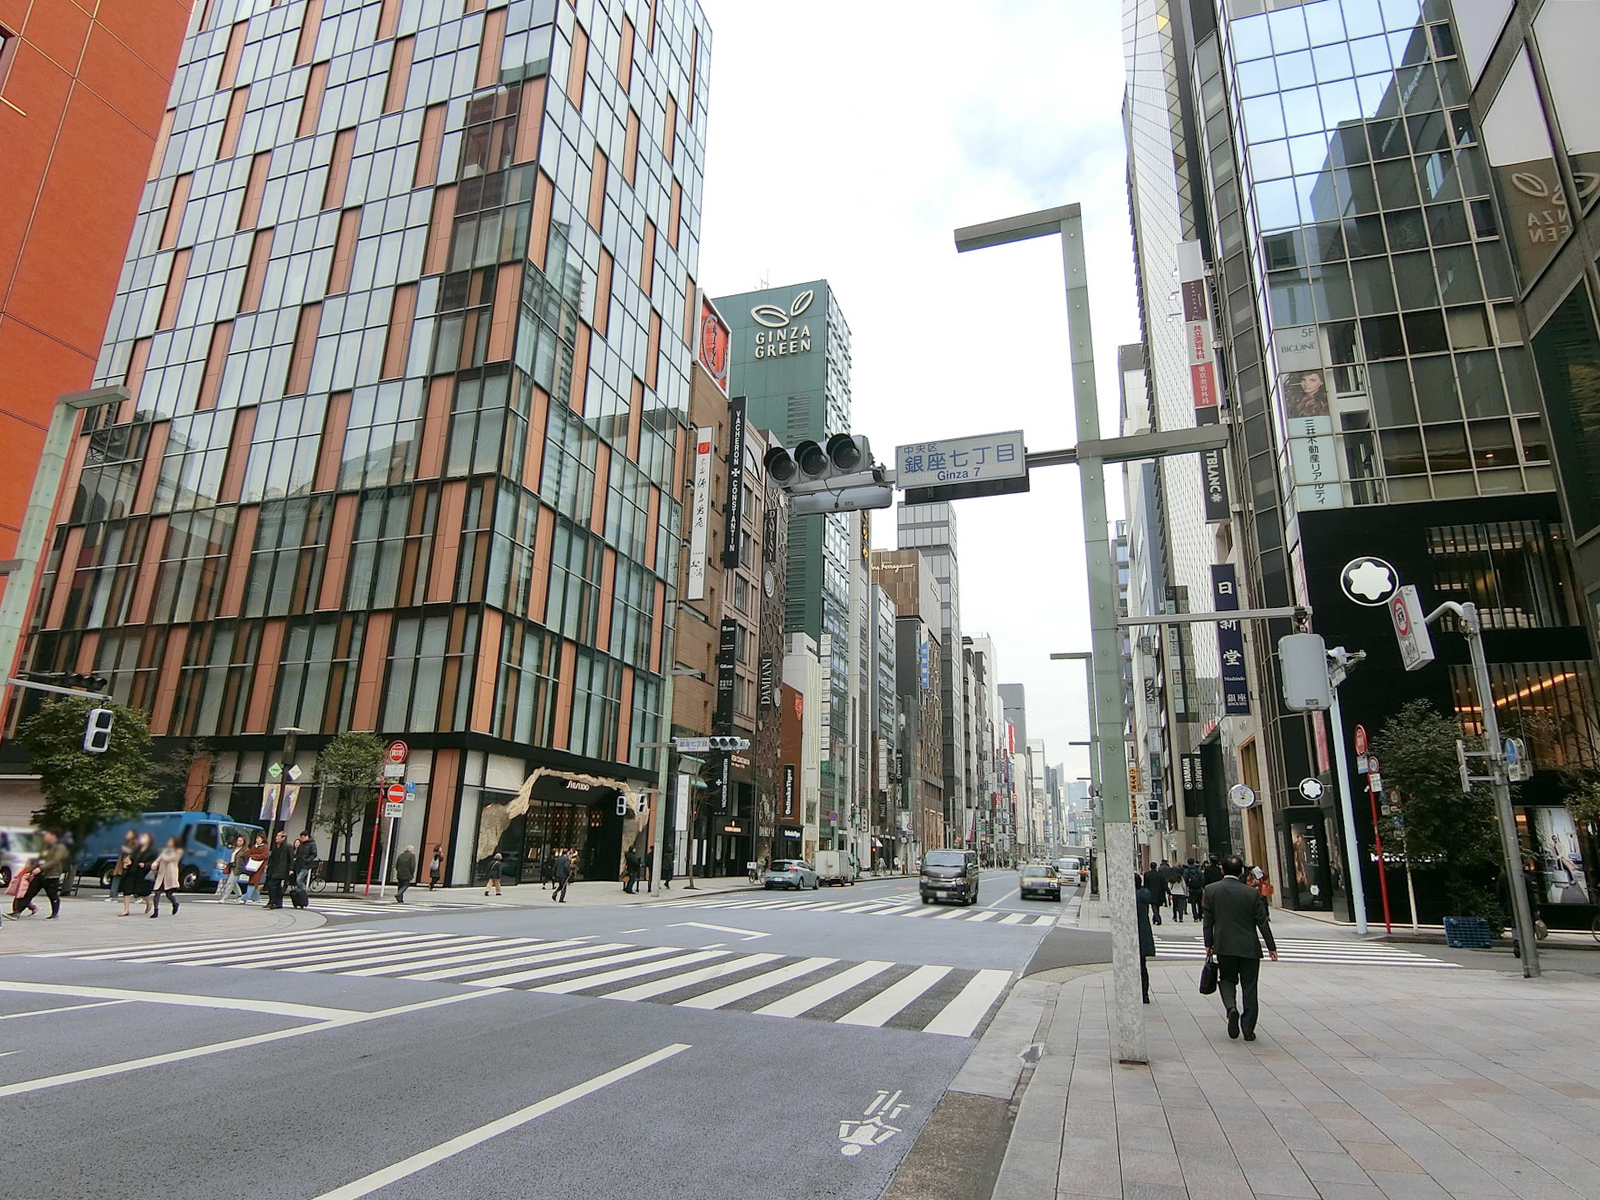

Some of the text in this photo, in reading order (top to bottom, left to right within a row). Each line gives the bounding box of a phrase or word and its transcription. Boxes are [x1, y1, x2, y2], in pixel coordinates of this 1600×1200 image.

[755, 324, 811, 345] GINZA
[1301, 327, 1314, 338] 5F
[754, 338, 811, 359] GREEN
[903, 443, 937, 455] 中央区
[904, 443, 1015, 474] 銀座七丁目
[937, 466, 981, 481] Ginza 7
[1305, 419, 1326, 505] 三井不動産リアルティ
[729, 410, 742, 552] VACHERON CONSTANTIN
[760, 658, 773, 705] DAMIANI
[1182, 757, 1192, 782] YAMAHA
